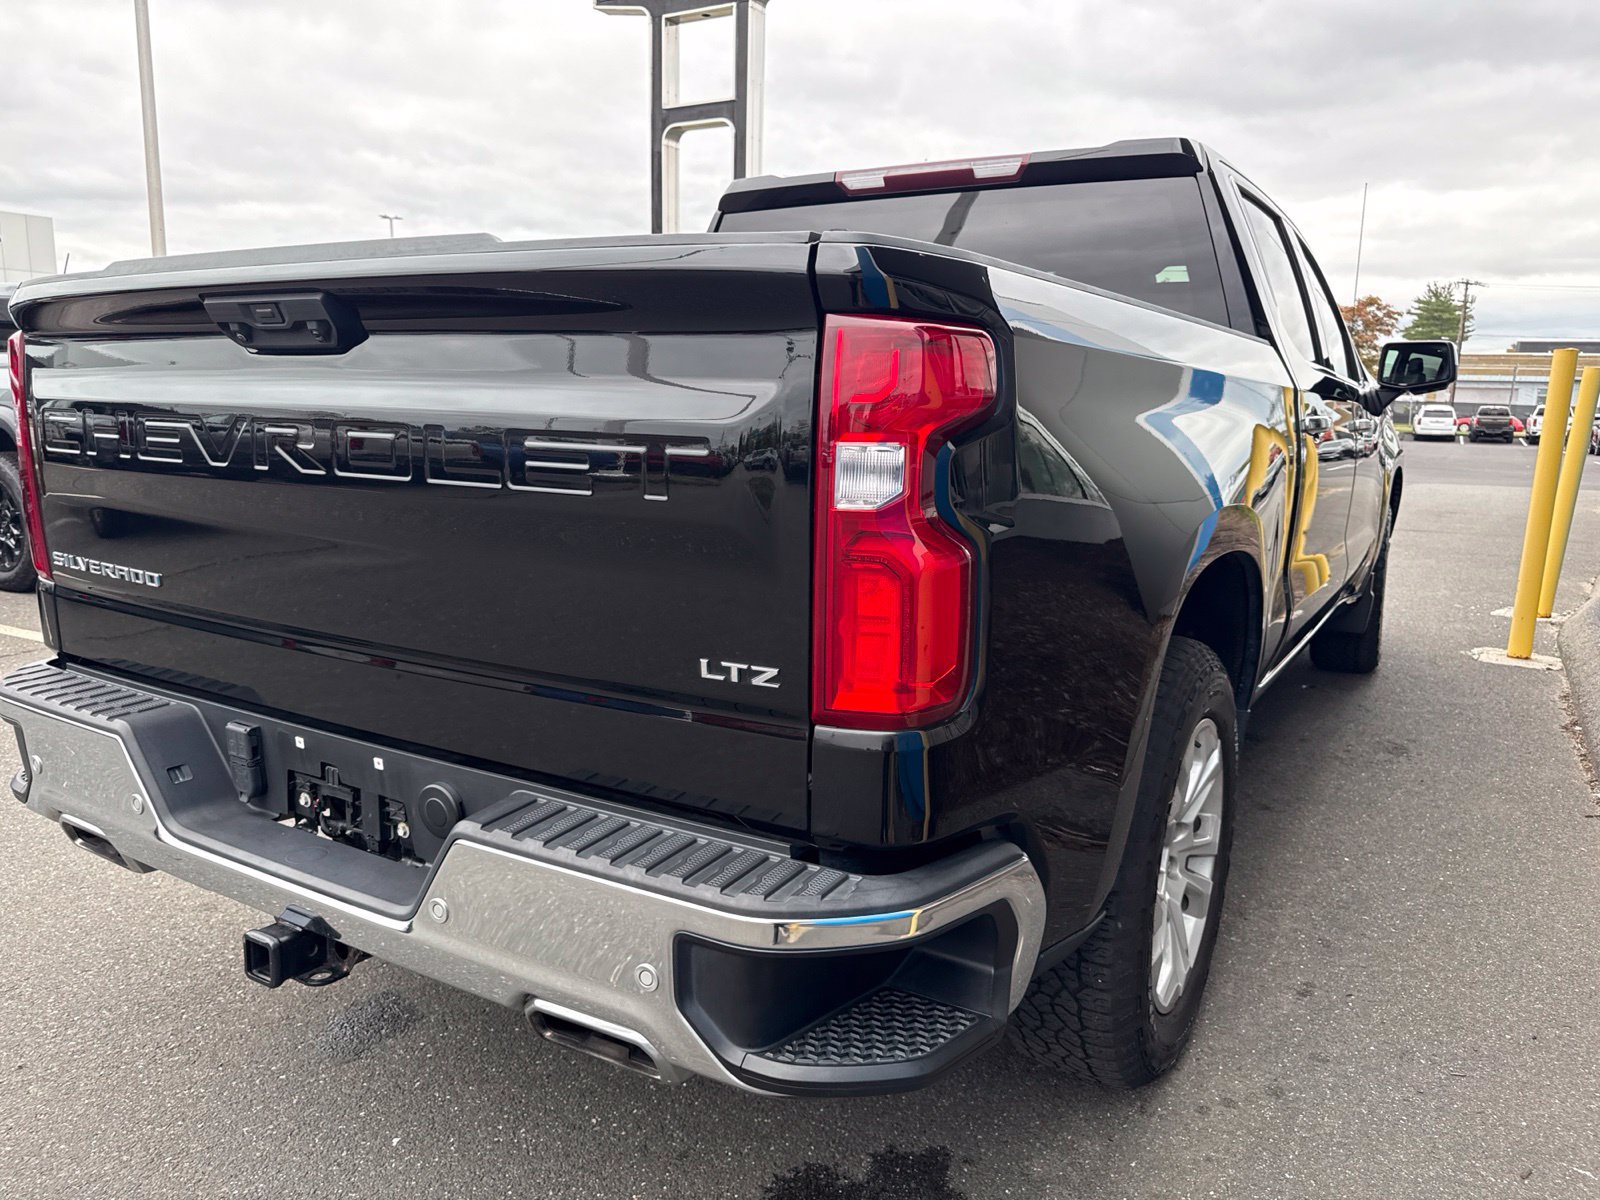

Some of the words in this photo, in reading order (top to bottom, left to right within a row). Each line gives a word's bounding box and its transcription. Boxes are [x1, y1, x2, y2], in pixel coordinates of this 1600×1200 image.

[42, 407, 710, 501] CHEVROLET
[52, 551, 162, 588] SILVERADO
[699, 658, 781, 688] LTZ
